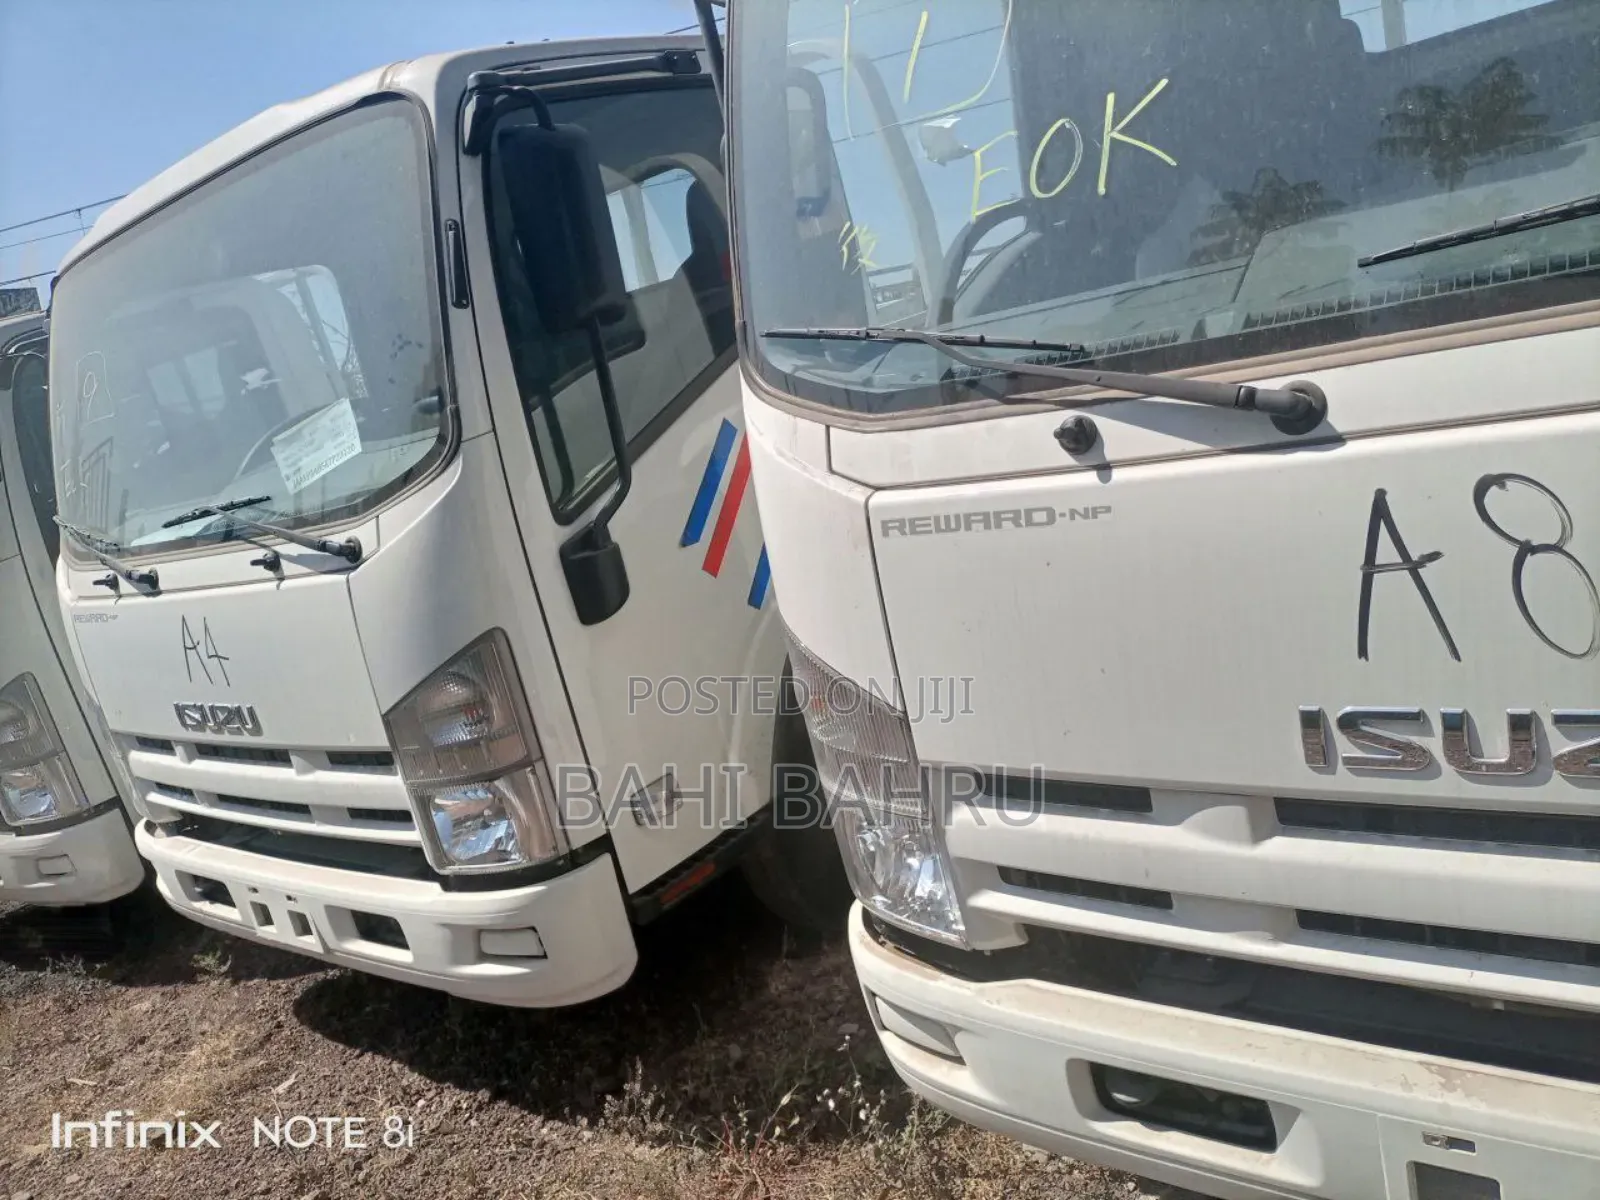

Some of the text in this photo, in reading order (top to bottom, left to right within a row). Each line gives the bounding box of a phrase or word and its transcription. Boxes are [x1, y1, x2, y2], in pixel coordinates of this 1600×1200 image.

[1357, 472, 1600, 662] A8
[181, 614, 231, 687] A4
[173, 701, 263, 736] ISUZU
